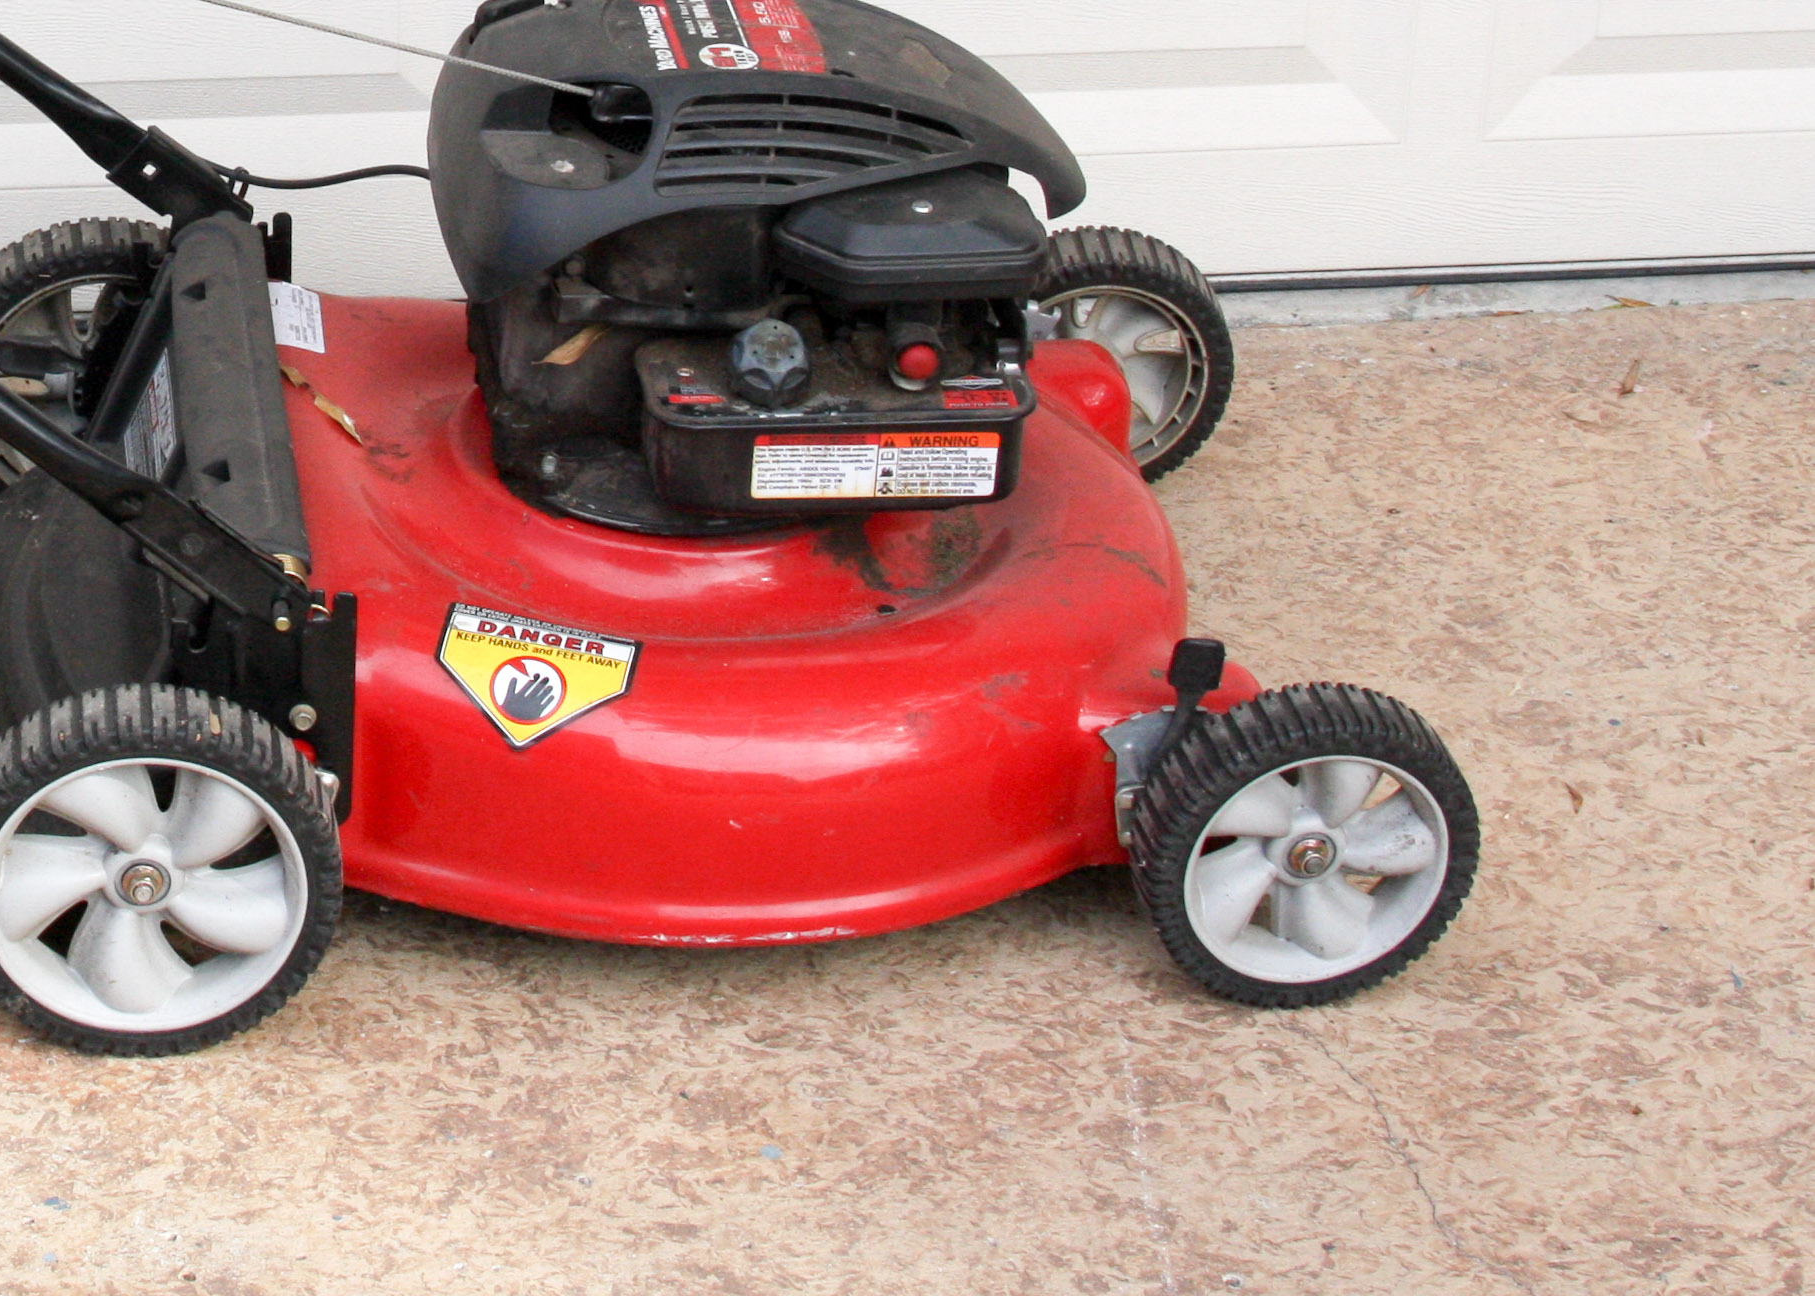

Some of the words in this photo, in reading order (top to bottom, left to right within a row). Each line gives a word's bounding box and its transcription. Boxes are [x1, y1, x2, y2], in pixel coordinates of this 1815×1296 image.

[638, 5, 670, 48] MACHINES
[655, 49, 678, 71] YARD
[909, 436, 978, 447] WARNING
[456, 631, 486, 643] KEEP
[489, 638, 529, 652] HANDS
[532, 646, 553, 656] and
[556, 650, 583, 662] FEET
[586, 654, 621, 669] AWAY
[477, 621, 605, 655] DANGER
